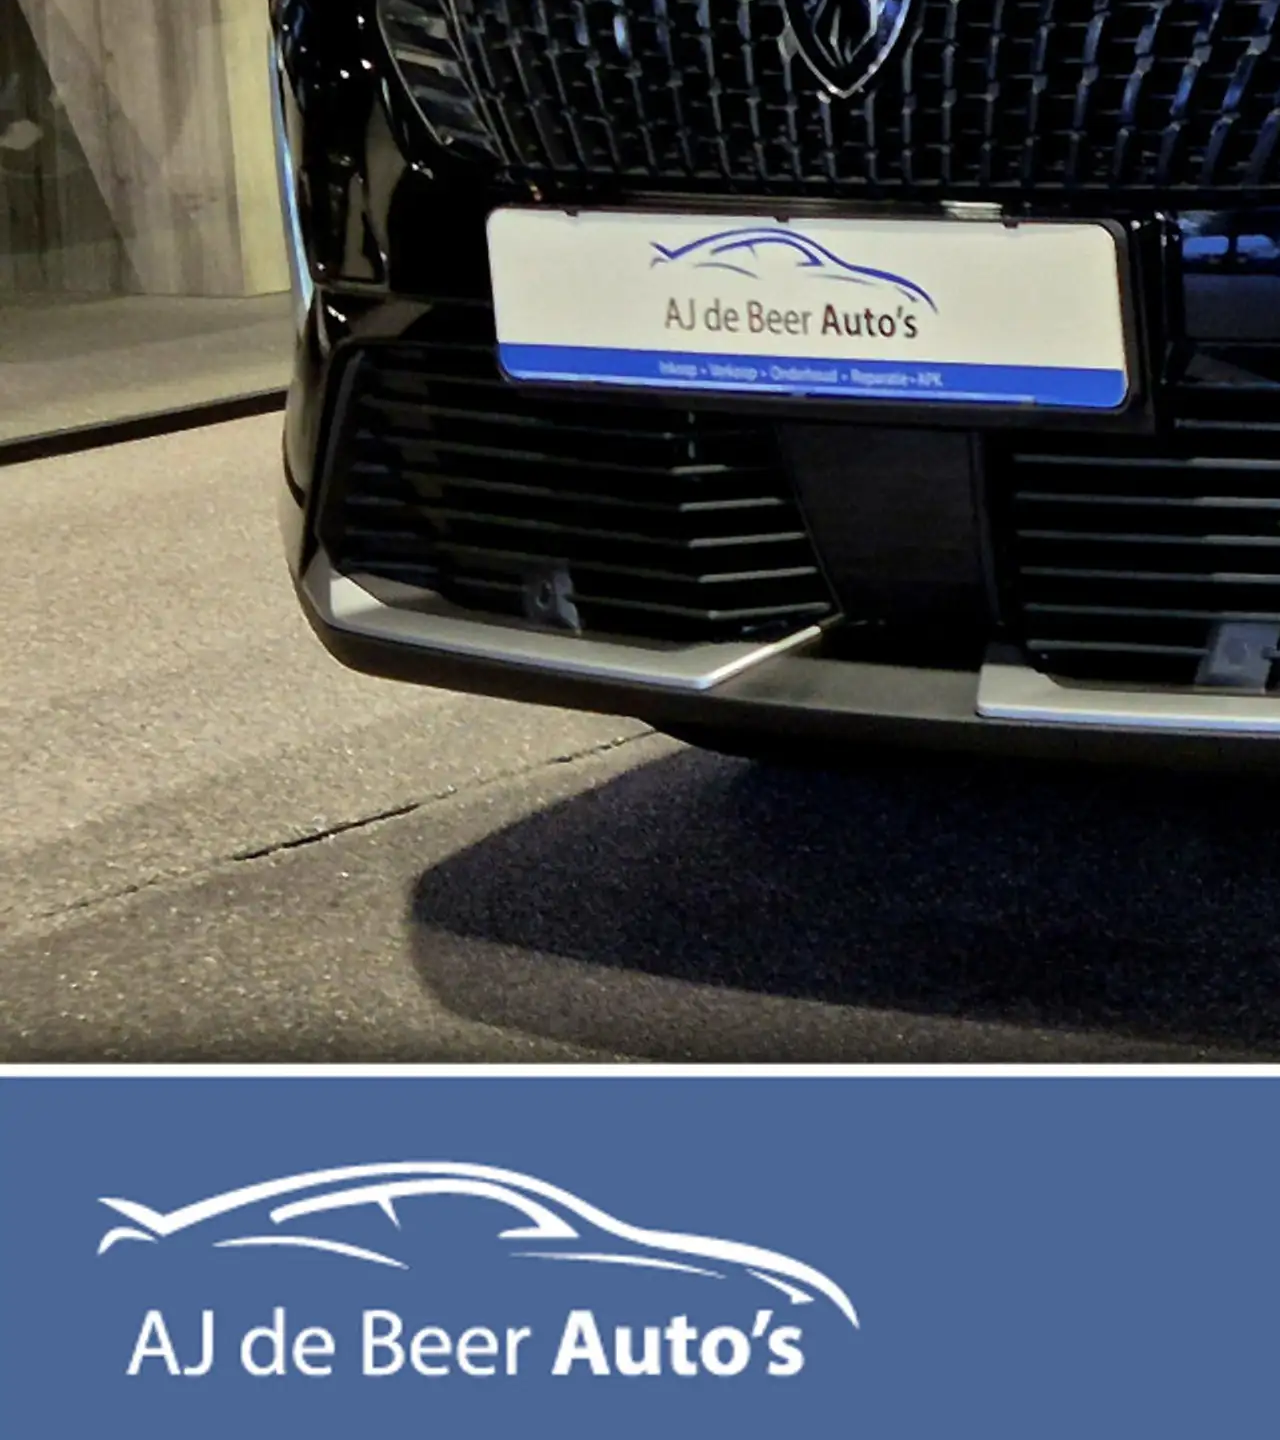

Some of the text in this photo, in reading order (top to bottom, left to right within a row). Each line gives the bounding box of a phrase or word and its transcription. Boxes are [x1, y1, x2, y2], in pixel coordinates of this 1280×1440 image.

[664, 297, 918, 339] AJ de Beer Auto's
